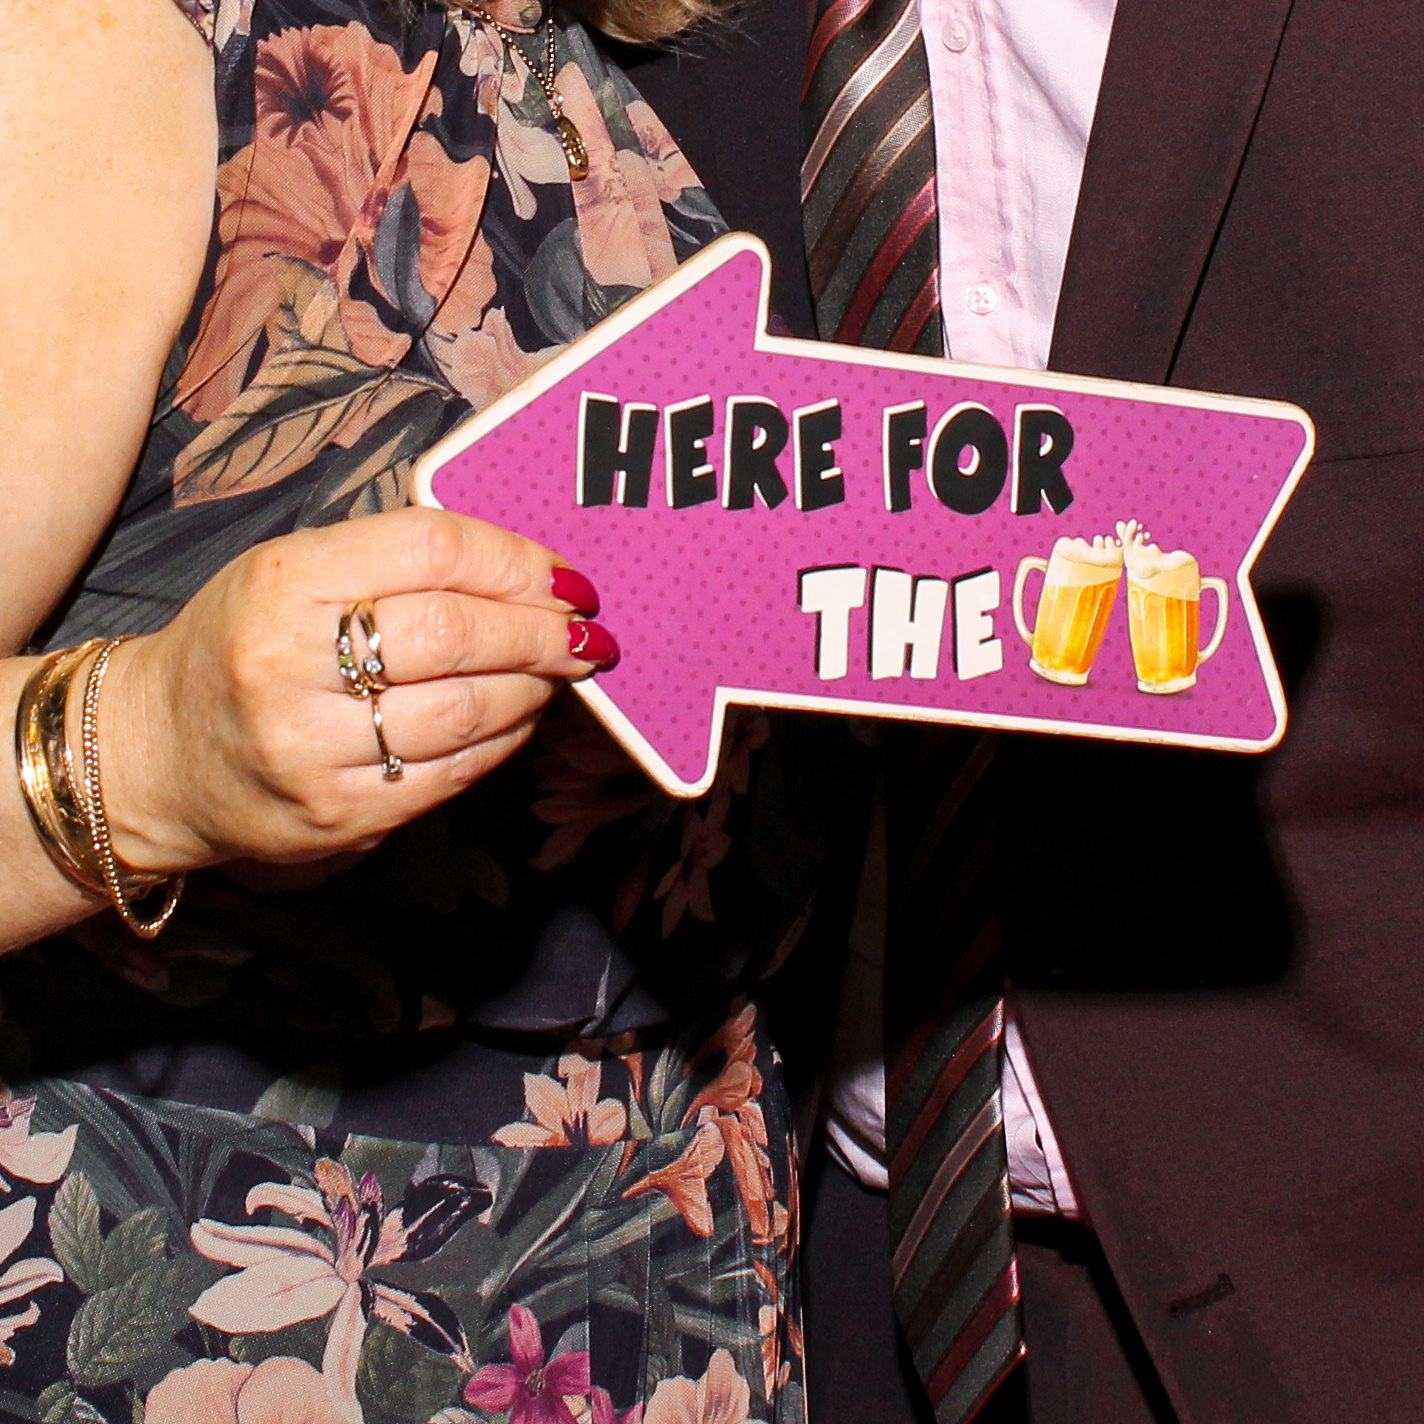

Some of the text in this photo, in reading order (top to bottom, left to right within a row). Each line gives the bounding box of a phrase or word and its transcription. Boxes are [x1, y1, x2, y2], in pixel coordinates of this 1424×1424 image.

[576, 391, 1075, 515] HERE FOR
[798, 565, 1004, 681] THE
